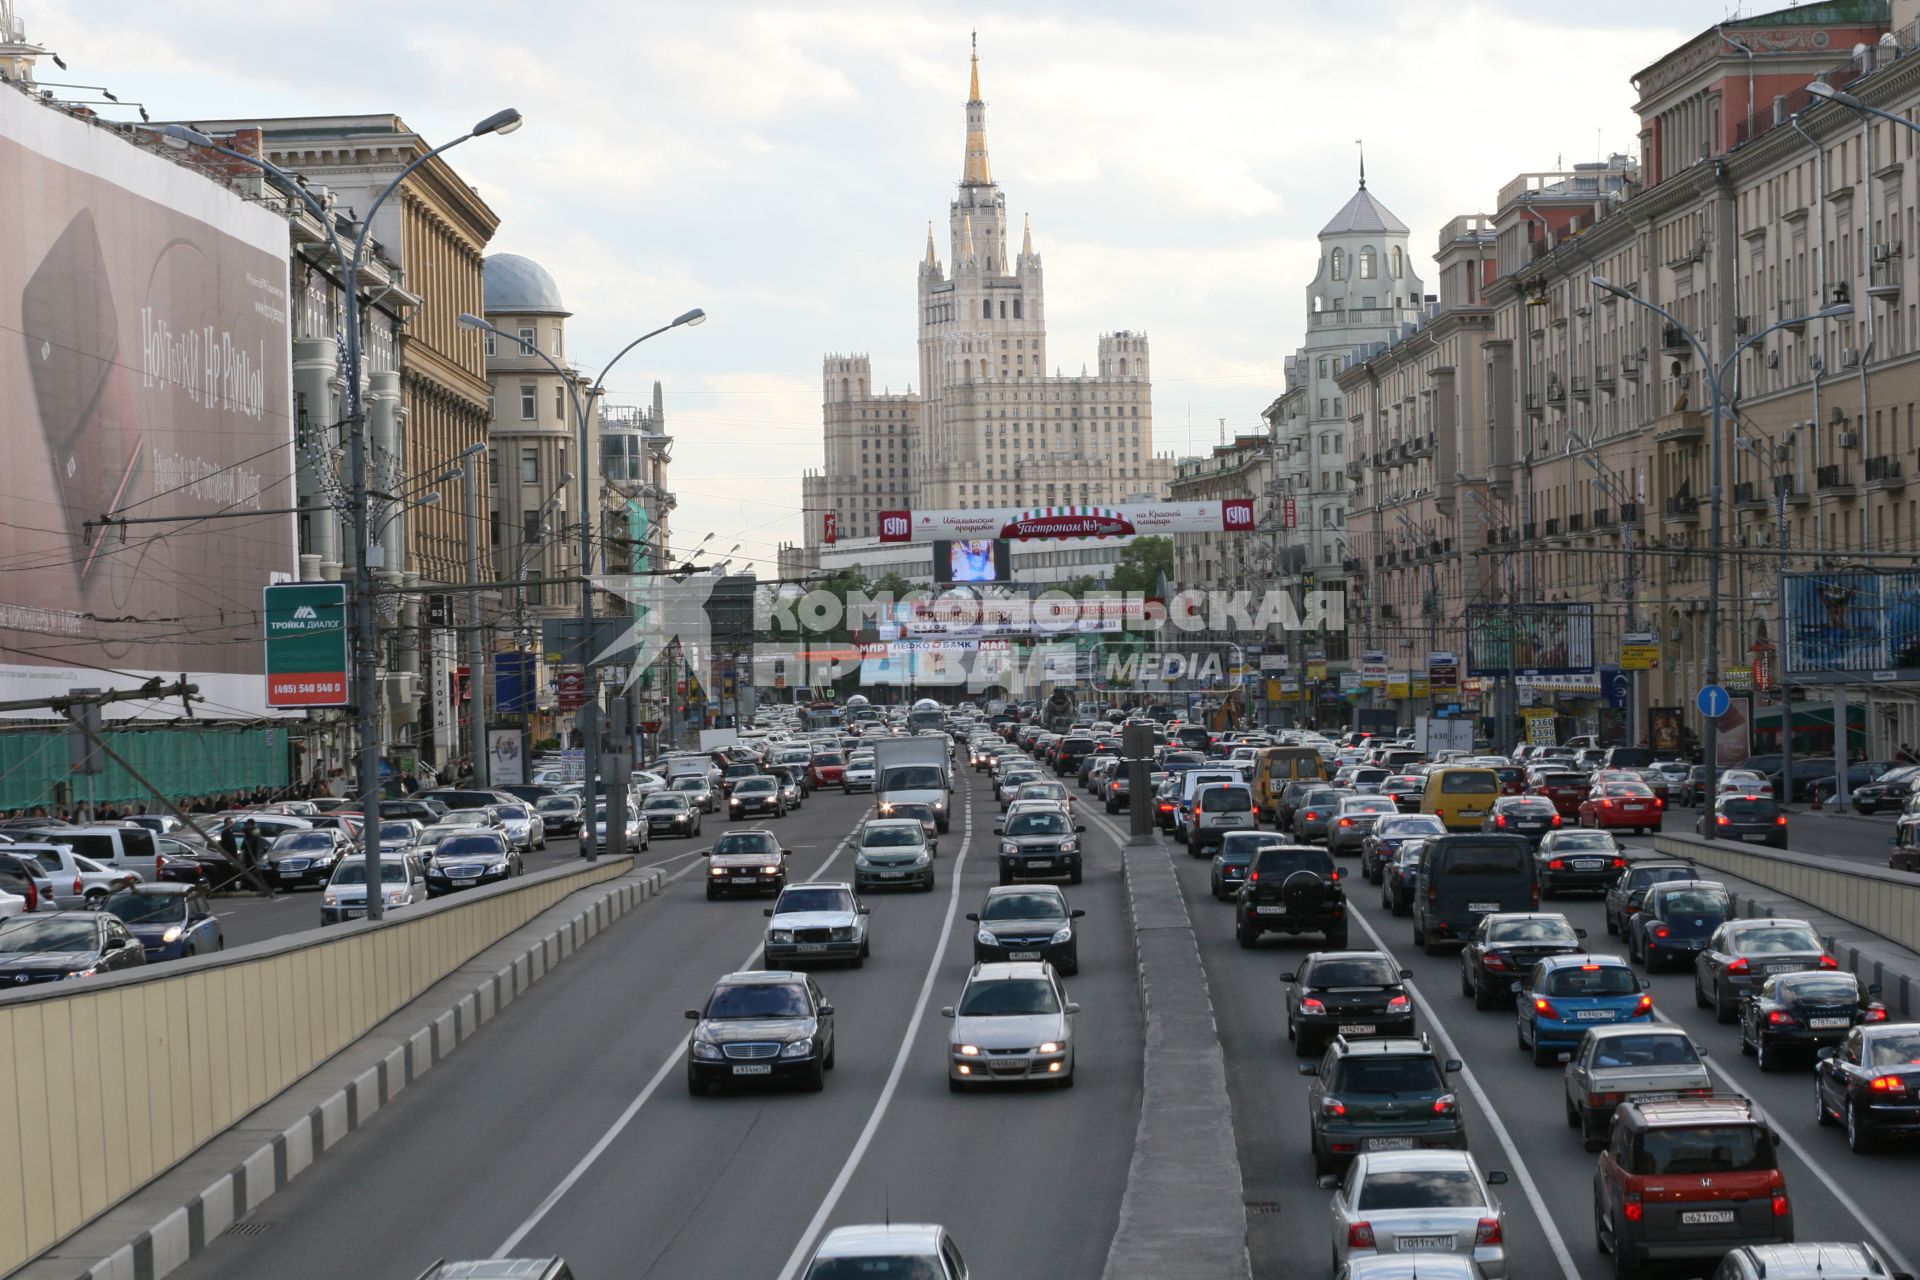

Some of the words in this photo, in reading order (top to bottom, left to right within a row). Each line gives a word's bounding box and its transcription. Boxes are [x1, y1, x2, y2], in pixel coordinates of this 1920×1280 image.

[942, 516, 995, 525] Итальянские
[1149, 509, 1181, 521] Красной
[1017, 521, 1082, 535] Гастроном
[1083, 519, 1098, 531] №1
[1136, 518, 1171, 527] площади
[955, 525, 994, 533] продукты
[1053, 604, 1080, 616] ОЛЕГ
[1080, 603, 1140, 616] МЕНЬШИКОВ
[270, 620, 305, 629] ТРОЙКА
[307, 620, 341, 630] ДИАЛОГ
[942, 639, 972, 650] БАНК
[274, 684, 297, 695] (495)
